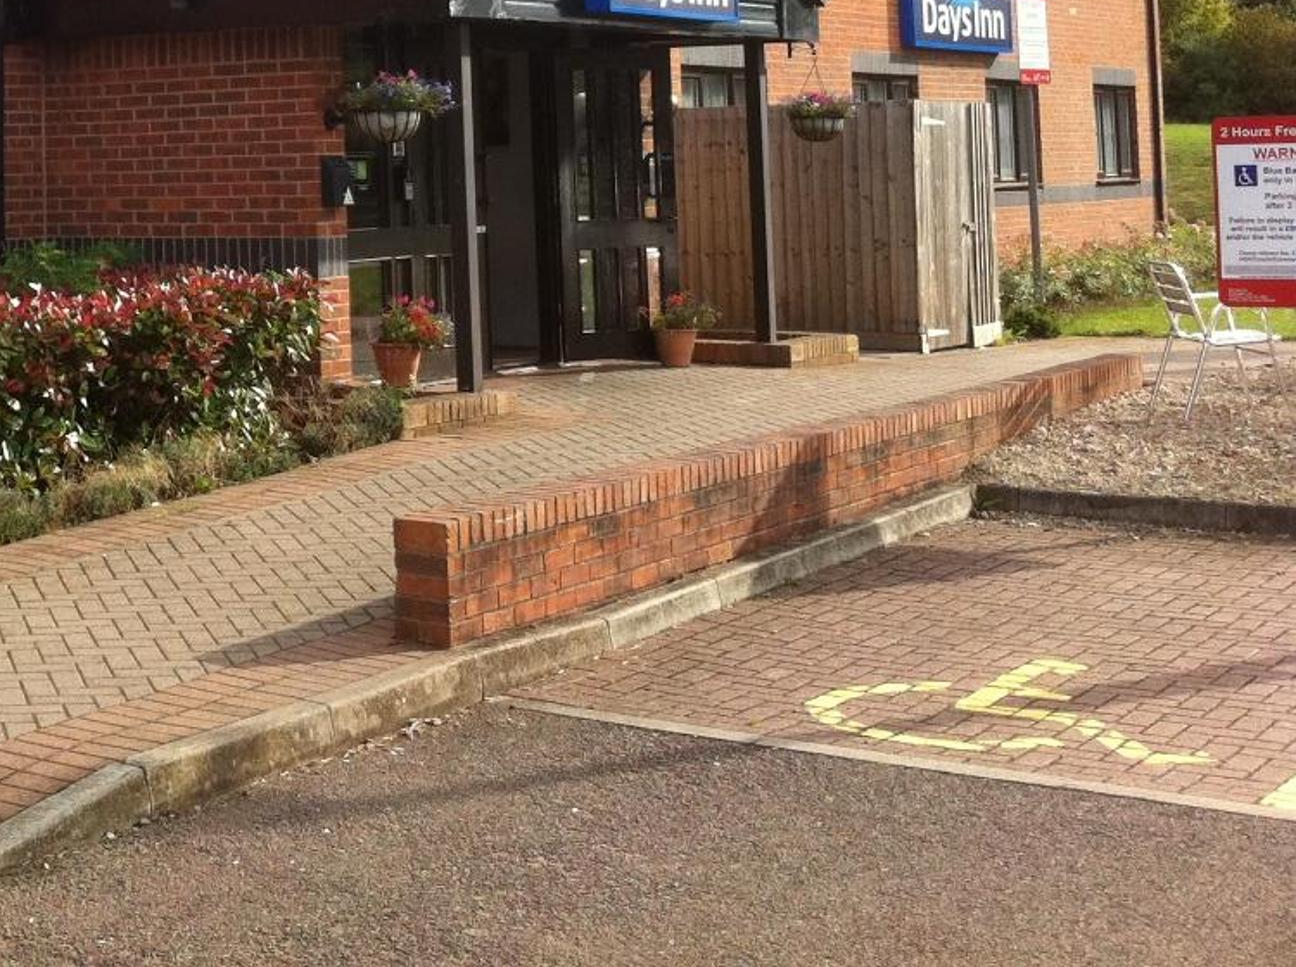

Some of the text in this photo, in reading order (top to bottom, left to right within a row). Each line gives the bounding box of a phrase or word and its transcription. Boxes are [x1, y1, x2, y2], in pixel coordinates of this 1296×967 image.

[973, 1, 1006, 40] Inn
[1220, 126, 1228, 138] 2
[1231, 126, 1271, 137] Hours
